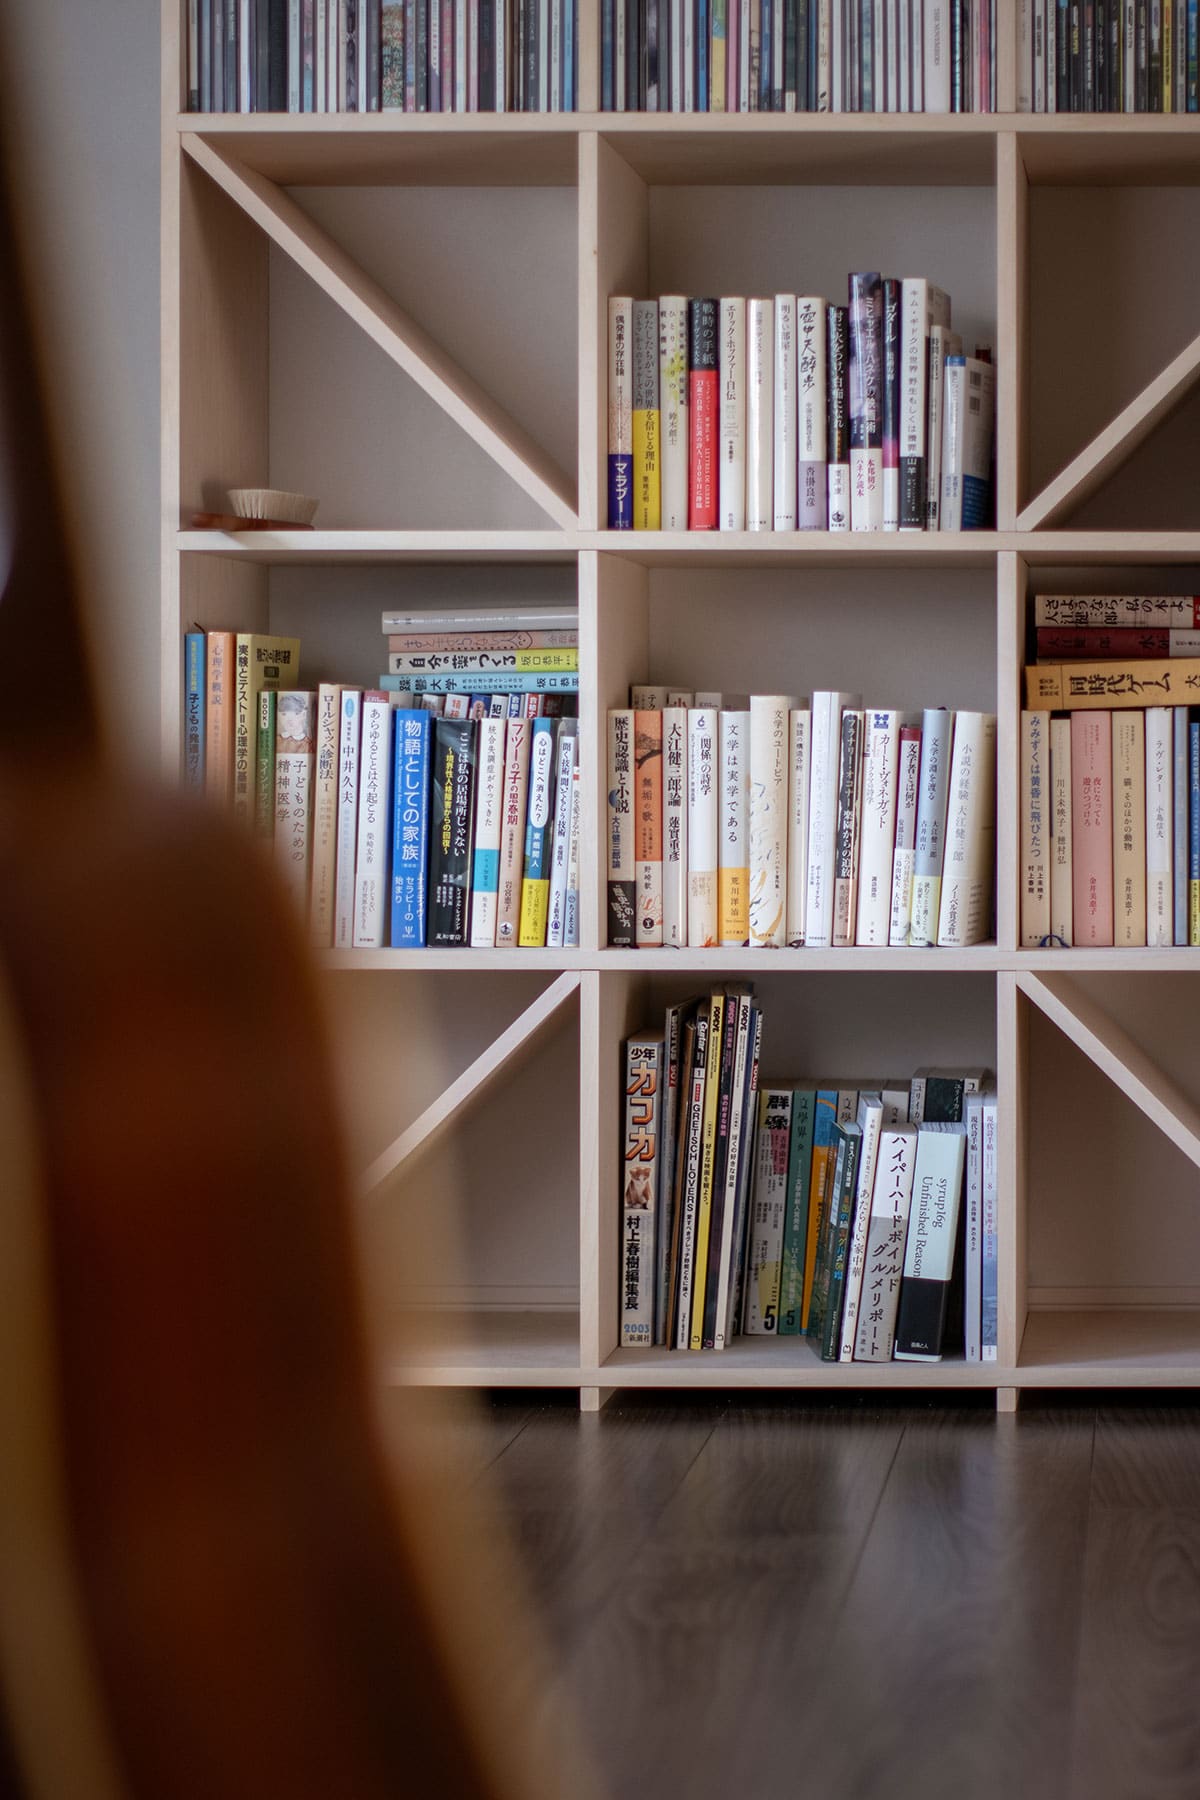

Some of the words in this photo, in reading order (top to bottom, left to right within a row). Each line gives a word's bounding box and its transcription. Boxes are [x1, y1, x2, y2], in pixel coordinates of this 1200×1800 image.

[615, 315, 625, 377] 偶発事の存在論
[702, 302, 715, 365] 戦時の手紙
[726, 305, 737, 401] エリック・ホッファー自伝
[800, 303, 817, 393] 壺中天酔歩
[643, 311, 655, 473] わたしたちがこの世界を信じる理由
[615, 462, 628, 513] マラブー
[211, 645, 223, 706] 心理学概説
[399, 676, 458, 692] 躁鬱大学
[408, 653, 517, 671] 自分の薬をつくる
[520, 654, 565, 667] 坂口恭平
[1069, 672, 1171, 697] 同時代ゲーム
[319, 694, 335, 782] ロールシャッハ診断法
[366, 708, 381, 824] あらゆることは今起こる
[614, 716, 630, 815] 歴史認識と小説
[667, 722, 682, 808] 大江健三郎論
[773, 710, 784, 786] 文学のユートピア
[277, 758, 291, 823] 精神医学
[342, 745, 355, 804] 中井久夫
[401, 720, 422, 861] 物語としての家族
[454, 732, 470, 857] ここは私の居場所じゃない
[484, 724, 497, 828] 統合失調症がやってきた
[506, 723, 525, 826] フツーの子の思春期
[535, 737, 548, 823] 心はどこへ消えた？
[726, 723, 739, 843] 文学は実学である
[880, 734, 892, 829] カート・ヴォネガット
[904, 743, 918, 809] 文学者とは何か
[927, 737, 940, 801] 文学の淵を渡る
[958, 743, 972, 801] 小説の経験
[1030, 715, 1041, 858] みみずくは黄昏に飛びたつ
[292, 759, 307, 862] 子どものための
[641, 777, 653, 823] 無垢の歌
[1082, 777, 1092, 828] 遊びつづけろ
[1093, 777, 1102, 827] 夜になっても
[1123, 777, 1133, 852] 猫、そのほかの動物
[611, 815, 621, 870] 大江健三郎論
[929, 820, 939, 858] 大江健三郎
[395, 875, 404, 905] 始まり
[405, 876, 415, 921] セラピーの
[730, 876, 739, 918] 荒川洋治
[947, 883, 959, 936] ノーベル賞受賞
[712, 1005, 721, 1033] POPEYE
[739, 1004, 749, 1032] POPEYE
[630, 1047, 656, 1061] 少年
[690, 1103, 701, 1162] GRETSCH
[764, 1094, 790, 1130] 群像
[686, 1163, 698, 1213] LOVERS
[885, 1136, 908, 1292] ハイパーハードボイルド
[917, 1176, 934, 1236] Unfinished
[932, 1177, 948, 1229] syrup16g
[624, 1215, 641, 1311] 村上春樹編集長
[851, 1188, 870, 1278] あたらしい家中華
[912, 1239, 927, 1278] Reason
[623, 1323, 650, 1334] 2003
[763, 1304, 777, 1331] 5
[786, 1309, 796, 1326] 5
[869, 1243, 889, 1356] グルメリポート
